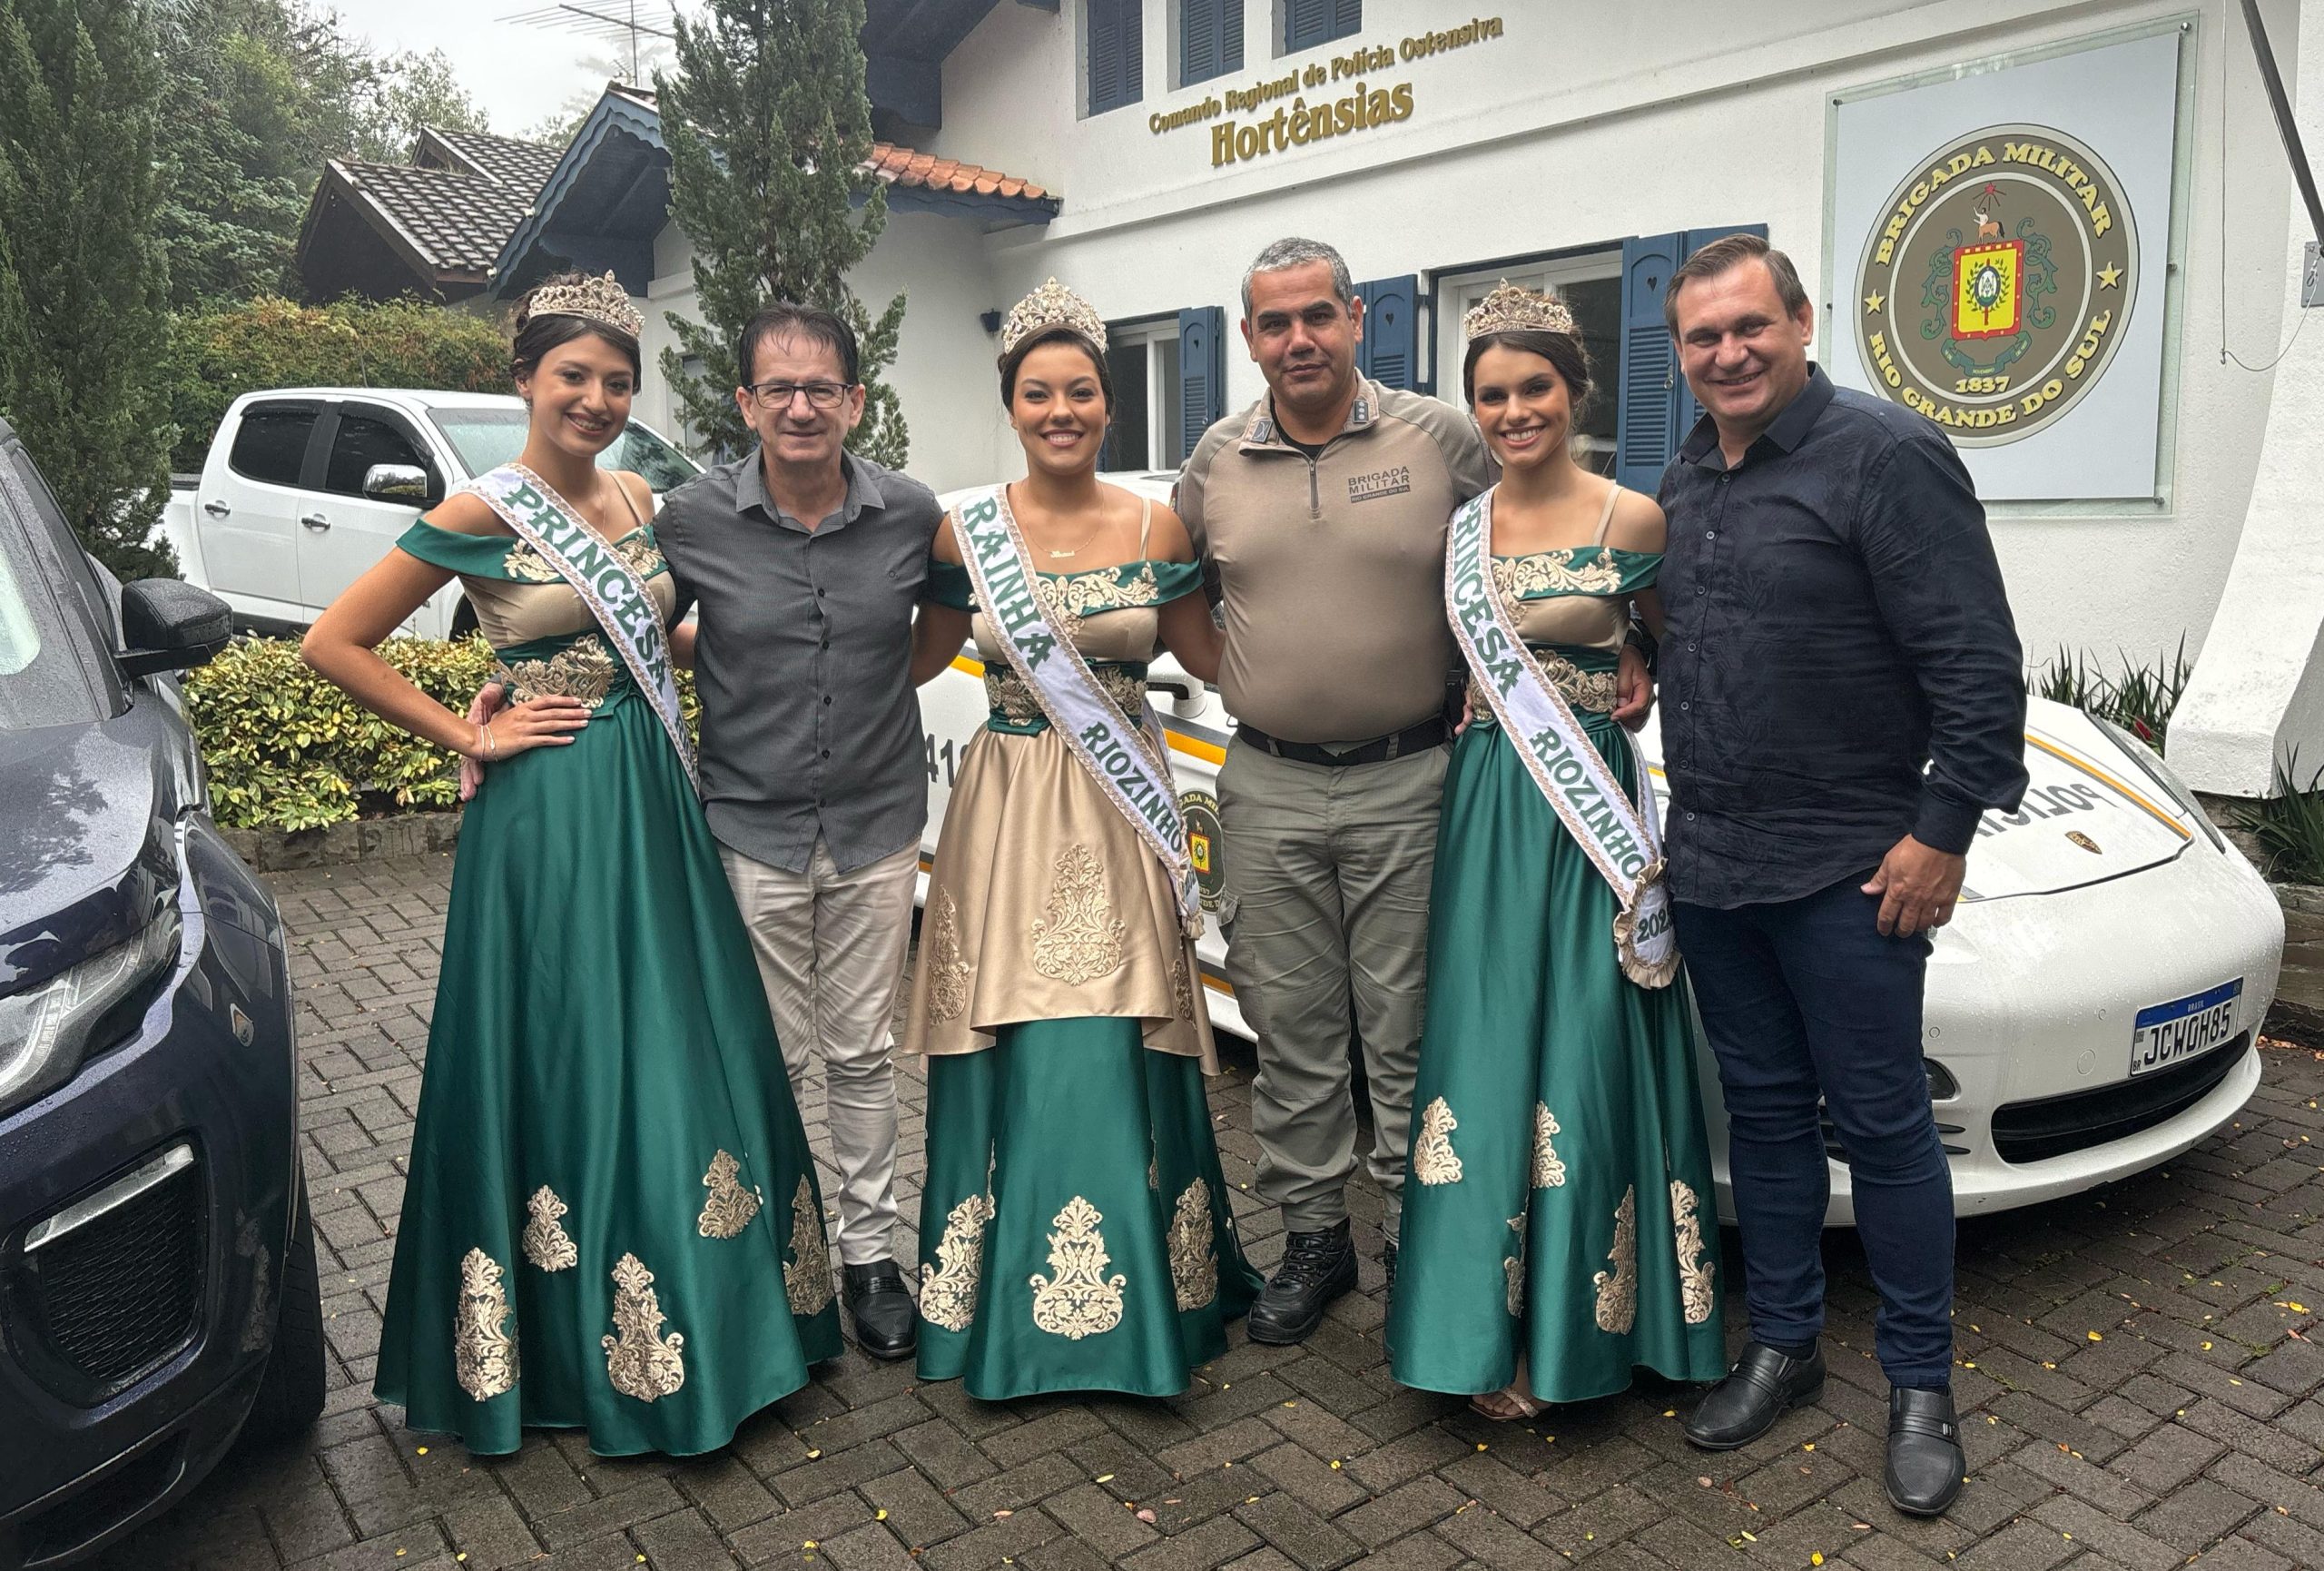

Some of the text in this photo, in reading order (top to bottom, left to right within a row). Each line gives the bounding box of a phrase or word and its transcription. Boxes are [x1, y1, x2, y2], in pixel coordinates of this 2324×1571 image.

[1148, 16, 1503, 133] Comando Regional de Polícia Ostensiva
[1211, 82, 1414, 167] Hortênsias
[1876, 143, 2113, 267] BRIGADA MILITAR
[1869, 309, 2112, 429] RIO GRANDE DO SUL
[1955, 375, 2011, 394] 1837
[1348, 466, 1410, 486] BRIGADA
[1349, 475, 1410, 494] MILITAR
[500, 482, 667, 699] PRINCESA
[963, 496, 1058, 674] RAINHA
[925, 733, 969, 788] 41
[1529, 726, 1648, 880] RIOZINHO
[2187, 1000, 2204, 1013] BRASIL
[2132, 1060, 2142, 1072] BR
